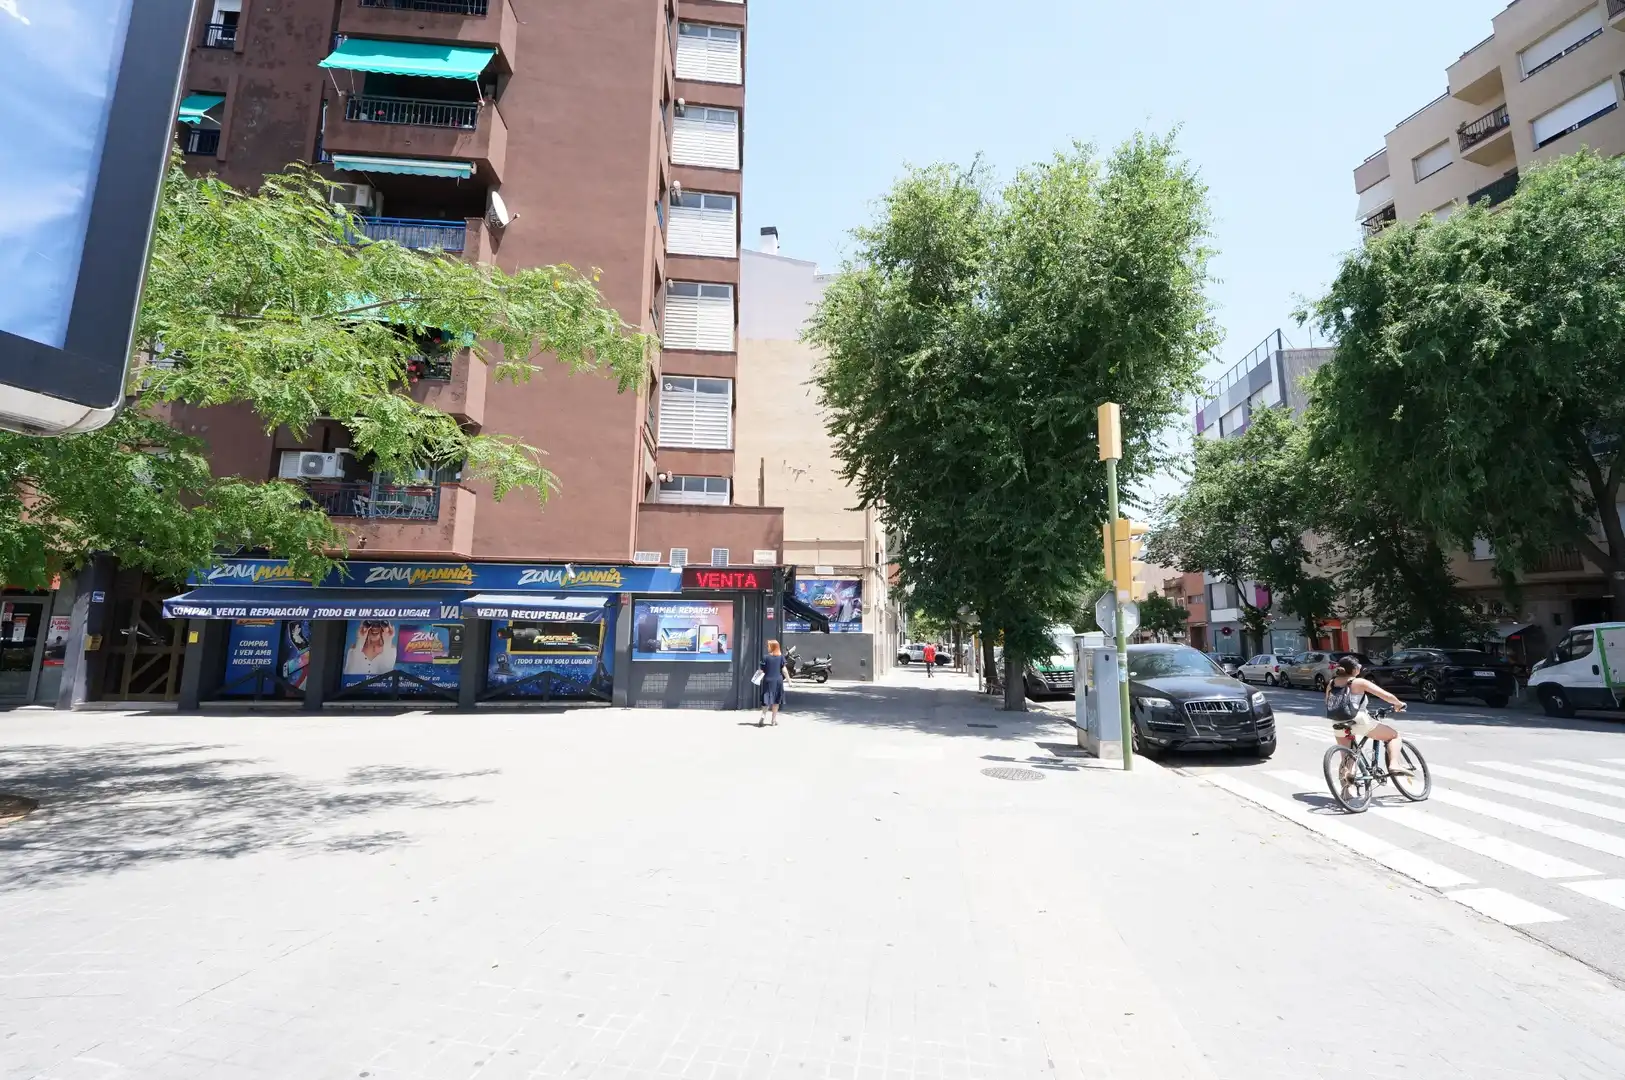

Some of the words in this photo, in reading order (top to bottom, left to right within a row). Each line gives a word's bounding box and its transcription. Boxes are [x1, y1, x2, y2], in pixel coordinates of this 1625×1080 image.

[696, 572, 757, 588] VENTA
[172, 607, 212, 617] COMPRA
[216, 607, 246, 617] VENTA
[250, 606, 309, 617] REPARACIÓN
[343, 608, 357, 617] EN
[358, 608, 372, 618] UN
[372, 608, 396, 618] SOLO
[398, 608, 430, 619] LUGAR!
[477, 608, 508, 618] VENTA
[511, 609, 586, 621] RECUPERABLE
[650, 605, 677, 614] TAMBÉ
[679, 606, 719, 615] REPAREM!
